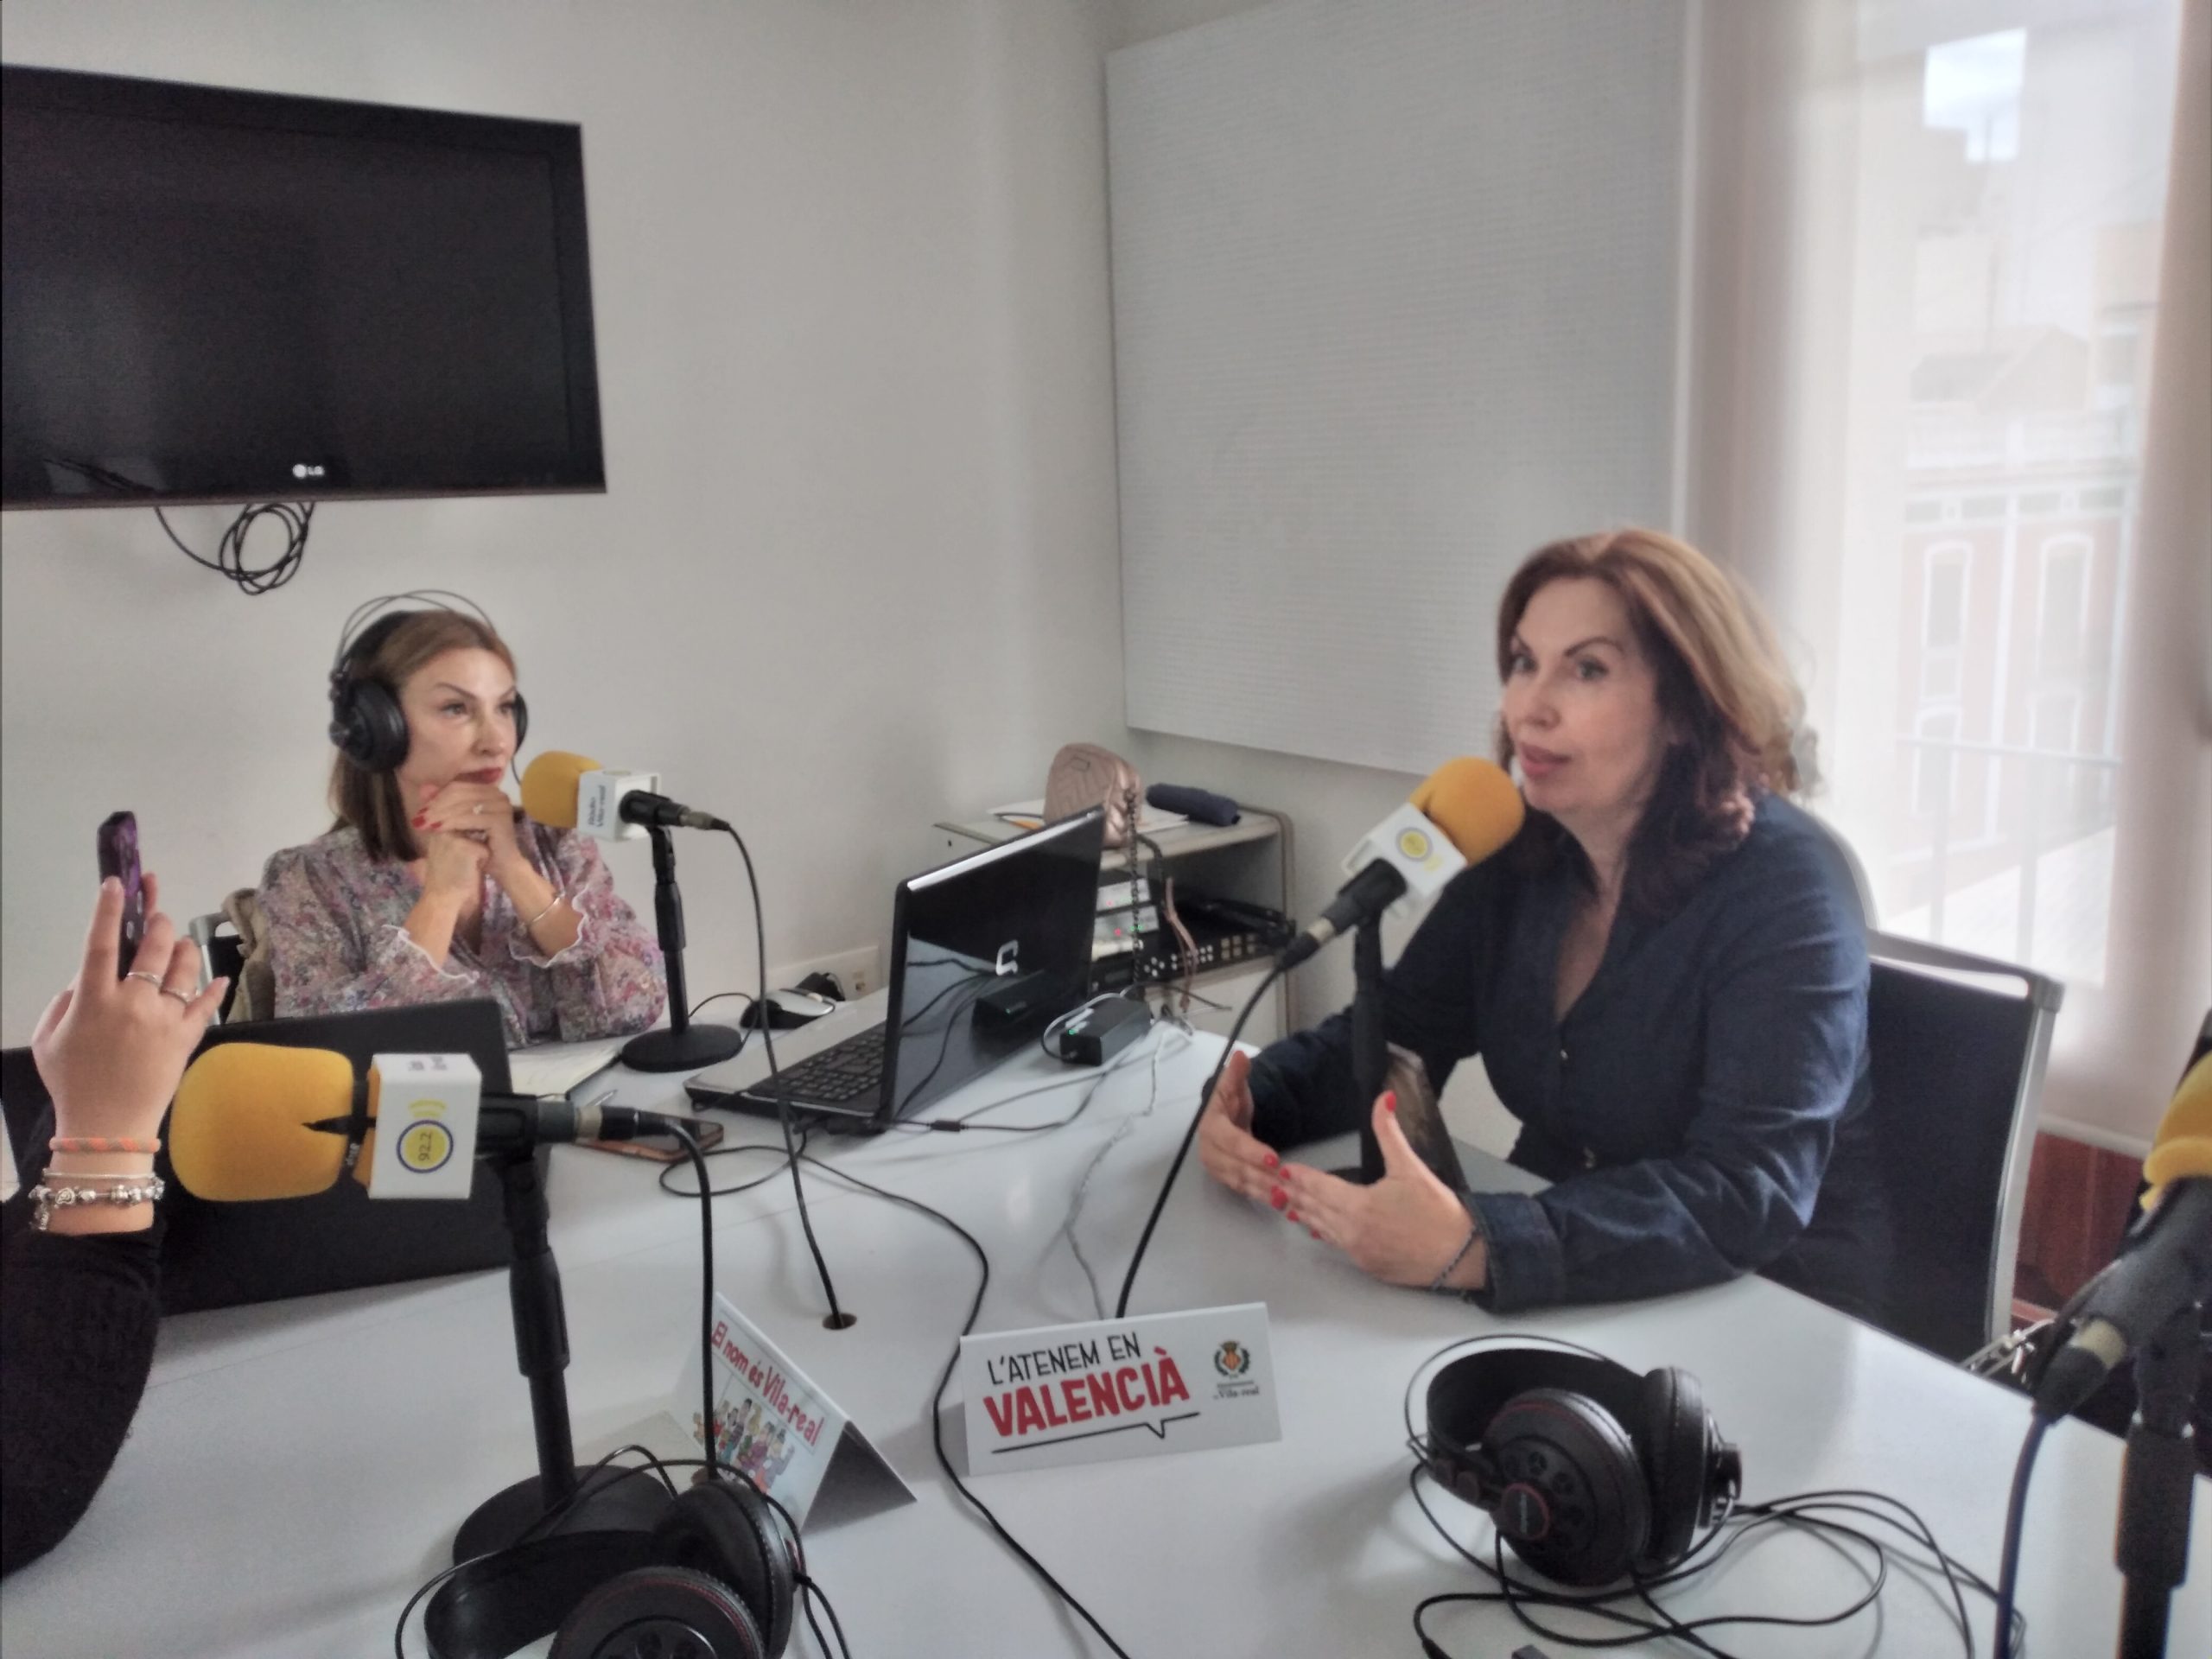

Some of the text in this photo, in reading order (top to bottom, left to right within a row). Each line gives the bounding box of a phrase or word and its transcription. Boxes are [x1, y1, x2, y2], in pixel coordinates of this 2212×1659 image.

[417, 1131, 433, 1161] 92.2
[711, 1320, 825, 1446] El nom és Vila-real
[983, 1346, 1191, 1437] VALENCIÀ
[988, 1332, 1141, 1385] L'ATENEM EN
